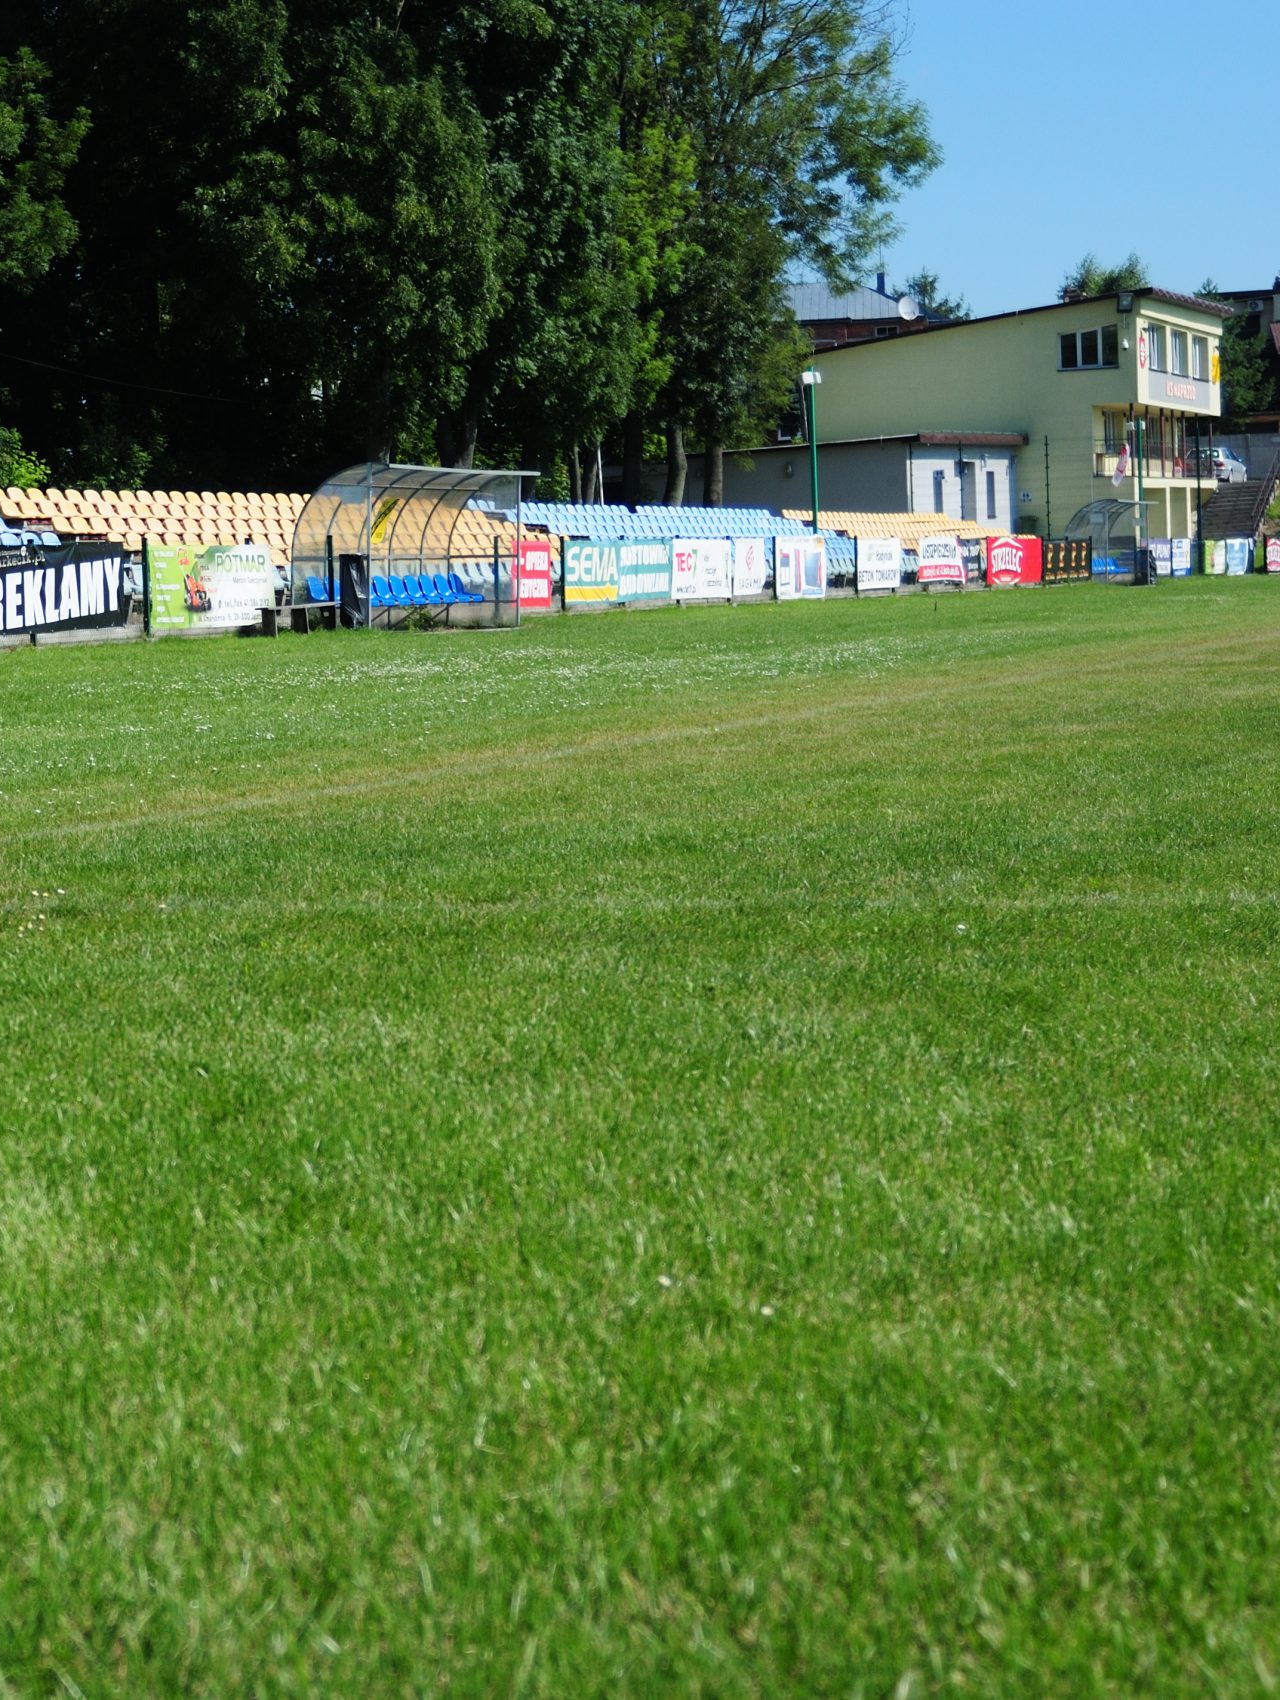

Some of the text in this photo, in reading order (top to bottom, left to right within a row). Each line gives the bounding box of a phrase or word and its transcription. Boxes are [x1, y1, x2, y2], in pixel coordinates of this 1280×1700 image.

[216, 554, 266, 573] POTMAR
[567, 546, 618, 582] SEMA
[991, 547, 1023, 573] STRZELEC
